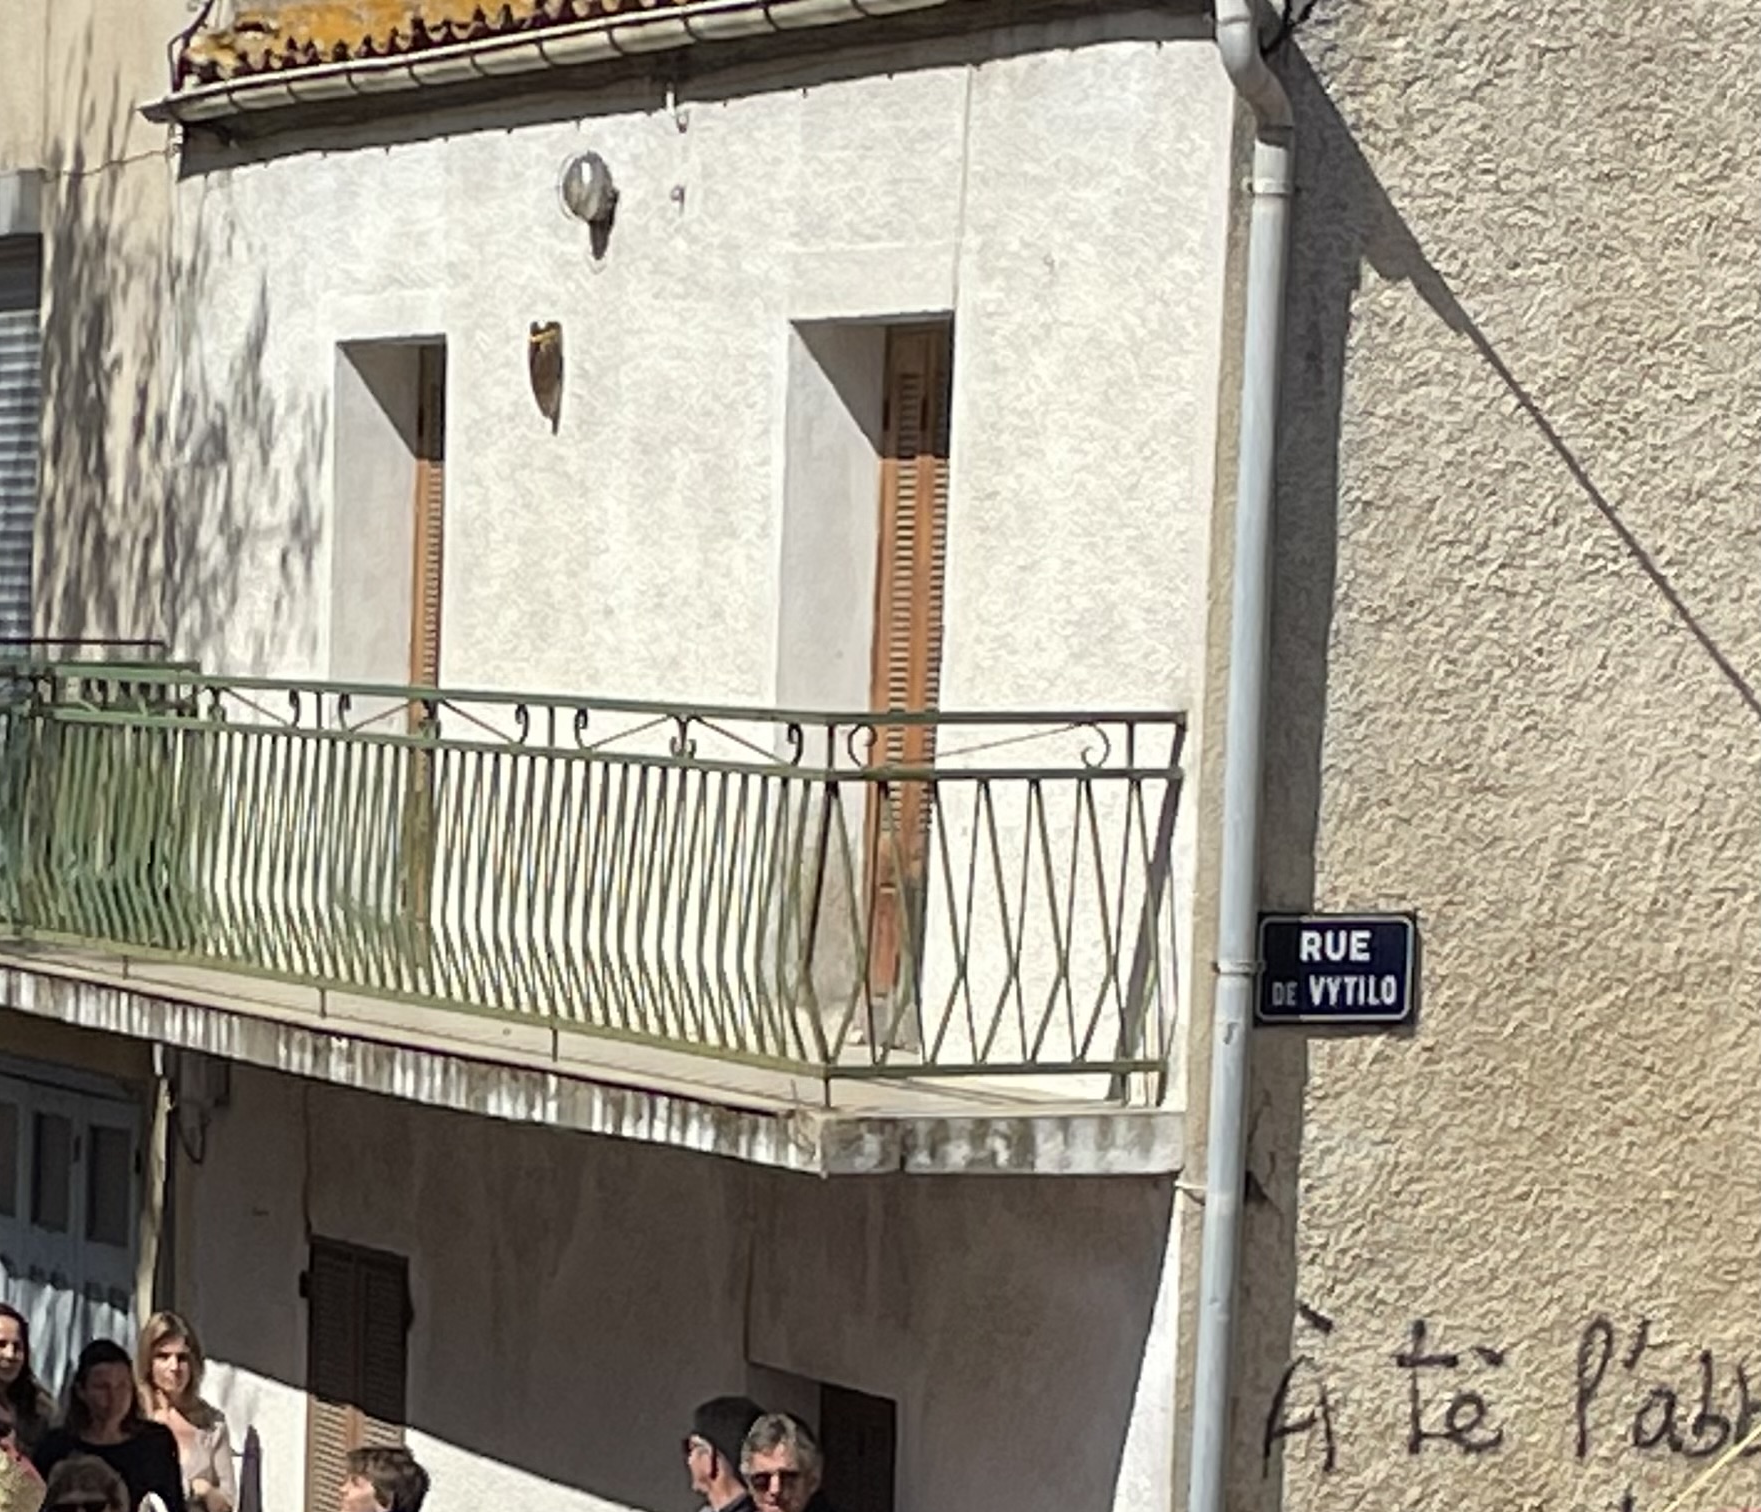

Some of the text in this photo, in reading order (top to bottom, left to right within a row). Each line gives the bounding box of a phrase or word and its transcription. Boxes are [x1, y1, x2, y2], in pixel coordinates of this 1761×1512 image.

[1299, 929, 1372, 962] RUE
[1271, 974, 1397, 1006] DE VYTILO
